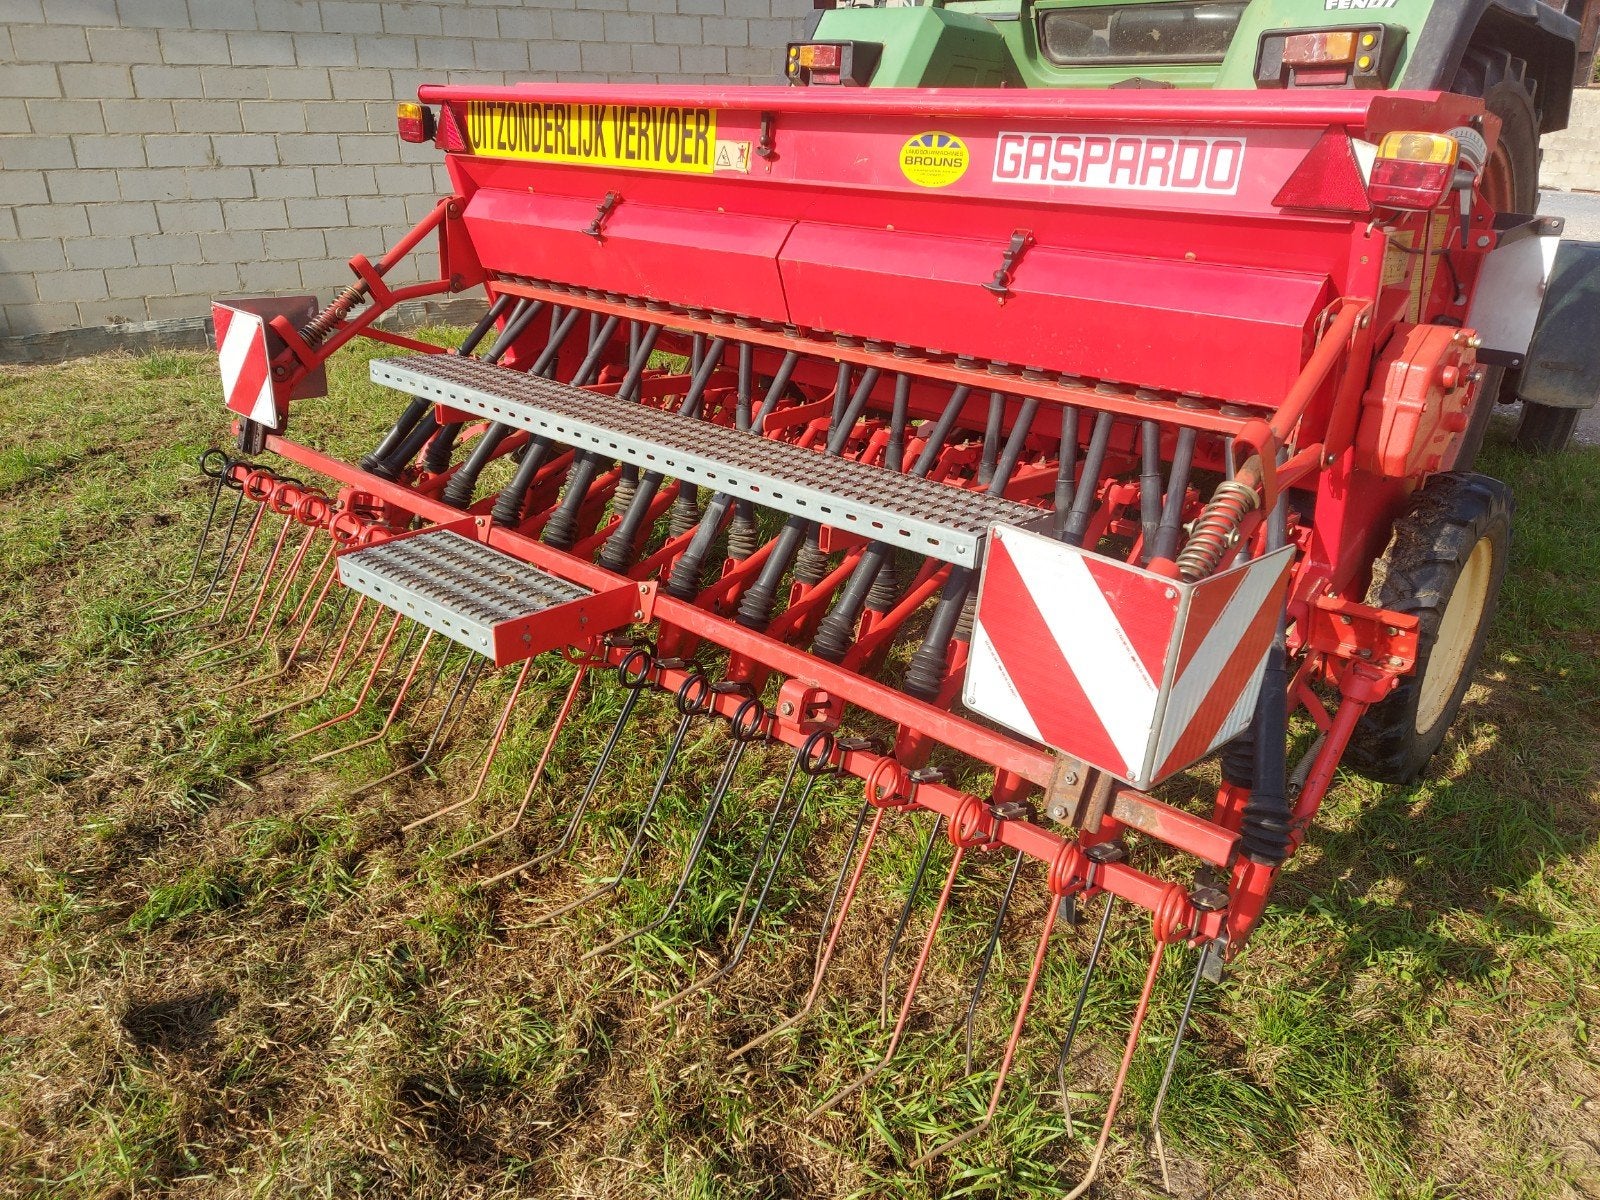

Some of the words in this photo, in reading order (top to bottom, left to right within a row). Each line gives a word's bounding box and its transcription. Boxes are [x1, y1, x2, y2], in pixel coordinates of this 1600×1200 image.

[471, 101, 607, 158] UITZONDERLIJK
[612, 105, 709, 165] VERVOER
[904, 156, 963, 168] BROUNS
[996, 134, 1240, 190] GASPARDO
